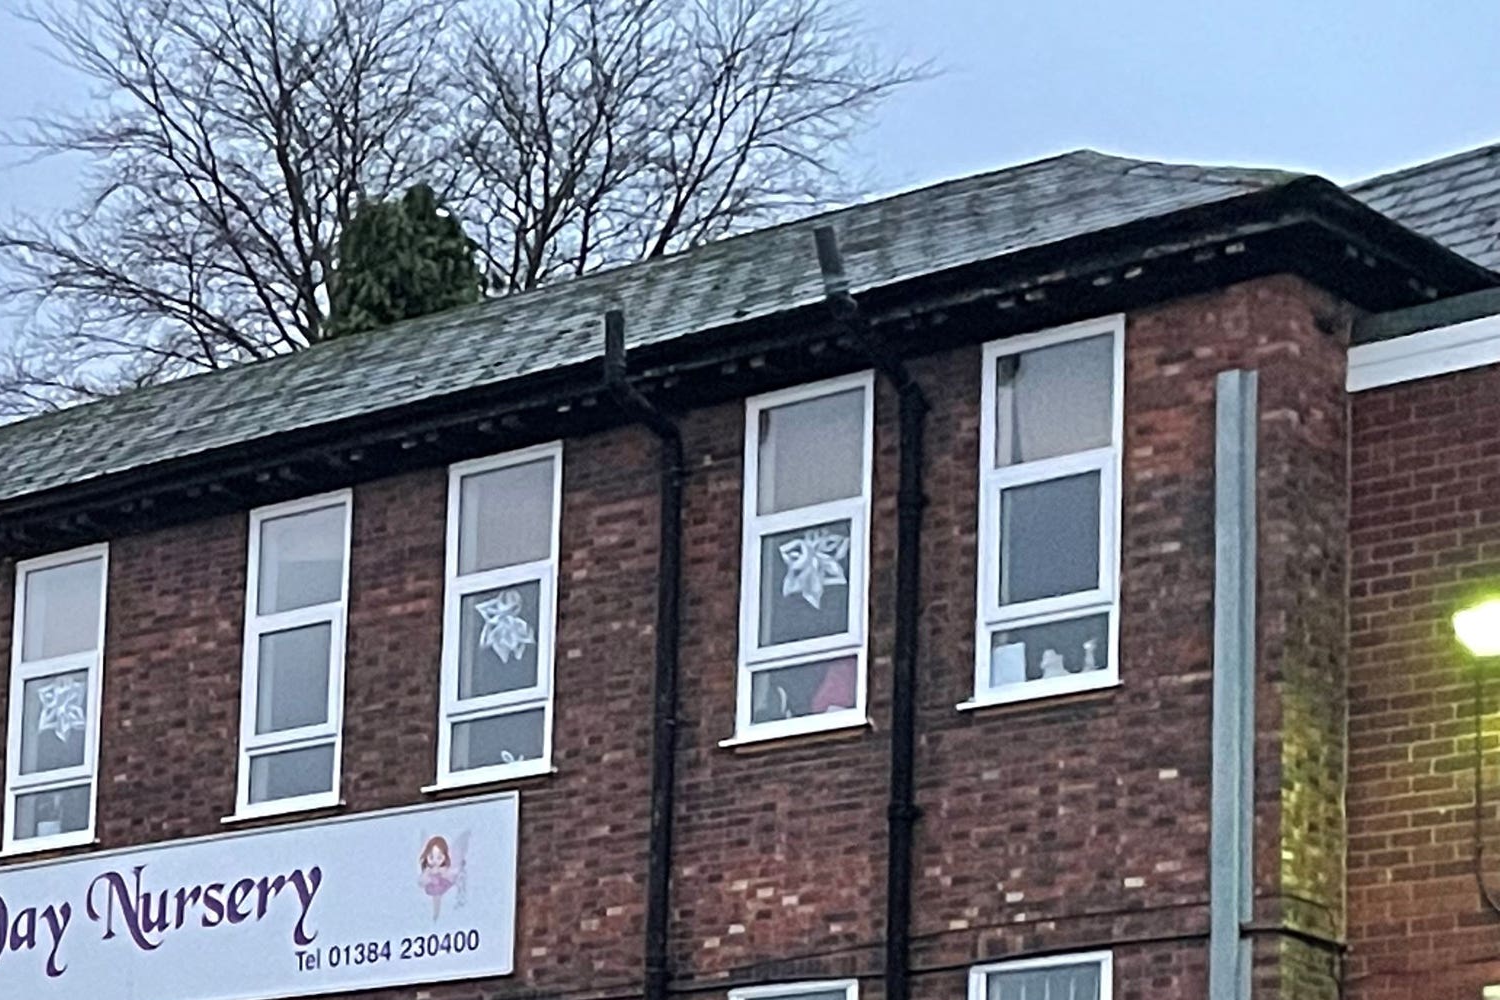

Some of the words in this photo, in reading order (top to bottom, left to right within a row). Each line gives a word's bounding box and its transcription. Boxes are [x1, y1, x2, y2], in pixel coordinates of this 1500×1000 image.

[86, 864, 322, 950] Nursery
[295, 947, 322, 972] Tel
[328, 939, 392, 968] 01384
[399, 928, 480, 960] 230400
